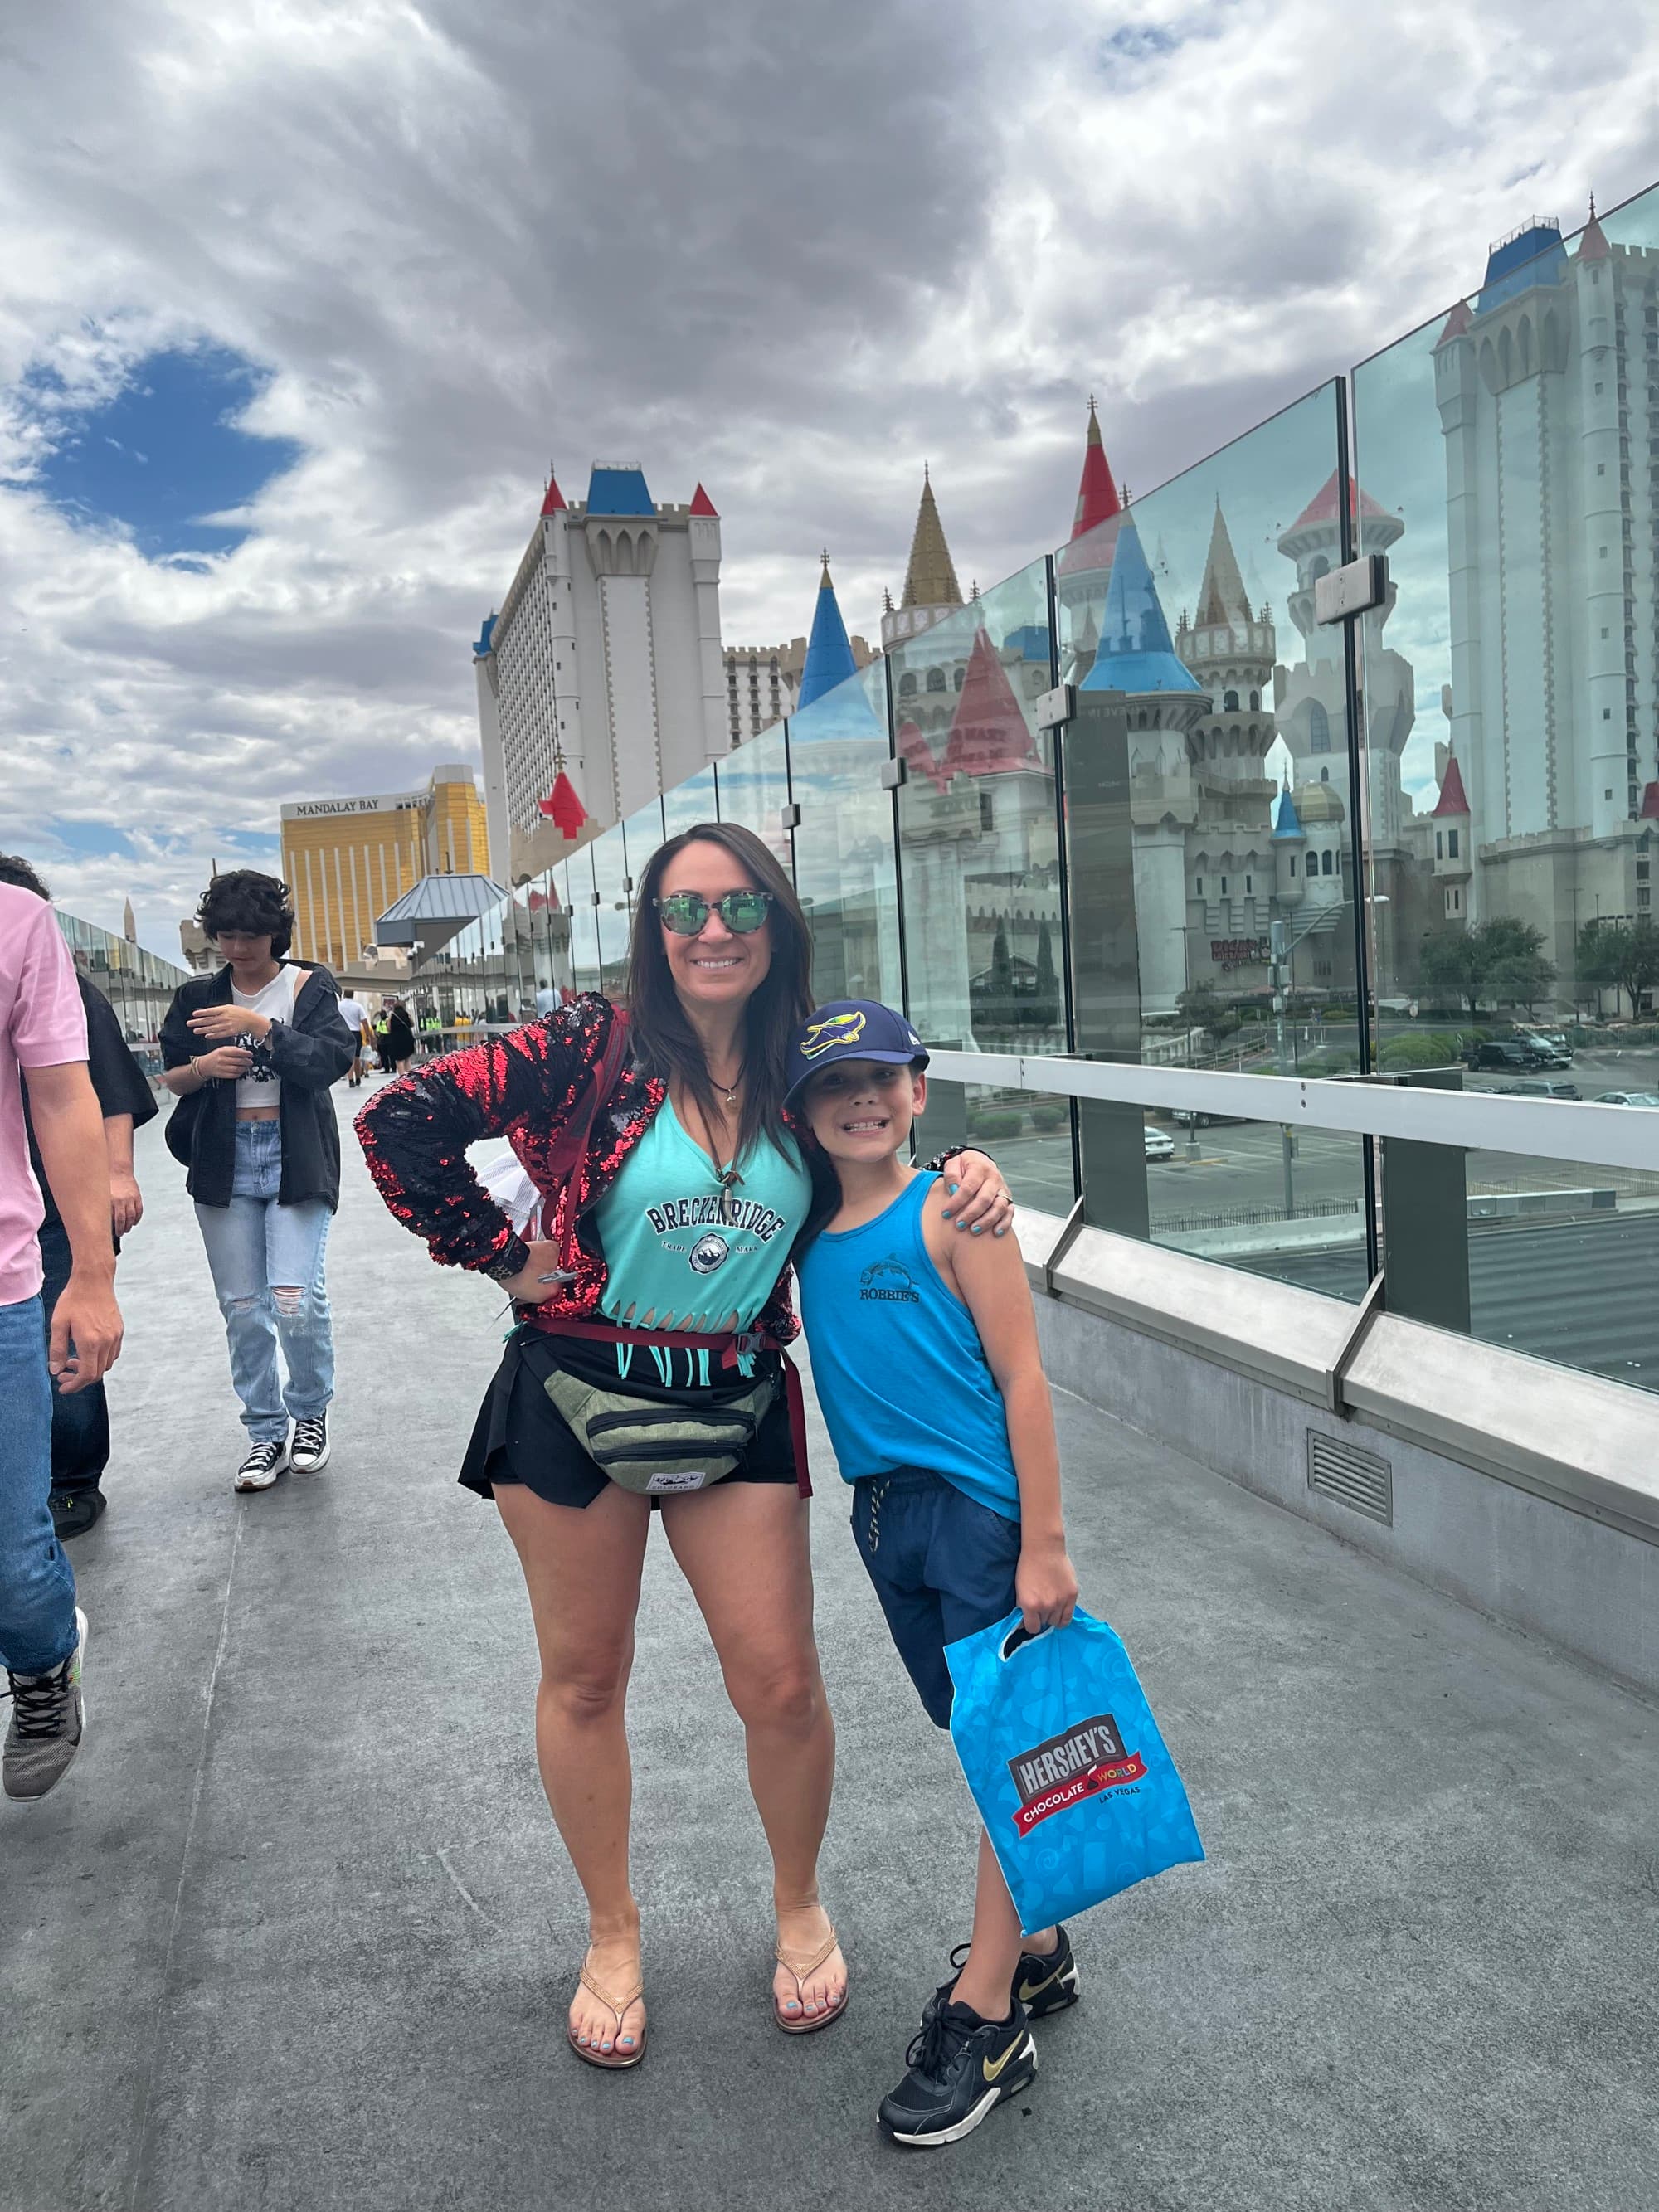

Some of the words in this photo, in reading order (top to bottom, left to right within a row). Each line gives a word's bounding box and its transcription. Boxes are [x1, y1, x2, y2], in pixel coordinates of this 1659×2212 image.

[297, 801, 357, 816] MANDALAY
[359, 799, 379, 810] BAY
[646, 1196, 786, 1243] BRECKENRIDGE
[859, 1288, 920, 1304] ROBBIE'S
[1019, 1725, 1117, 1795] HERSHEY'S
[1024, 1782, 1084, 1823] CHOCOLATE
[1097, 1763, 1137, 1783] WORLD
[1099, 1793, 1113, 1804] LAS
[1114, 1787, 1141, 1796] VEGAS
